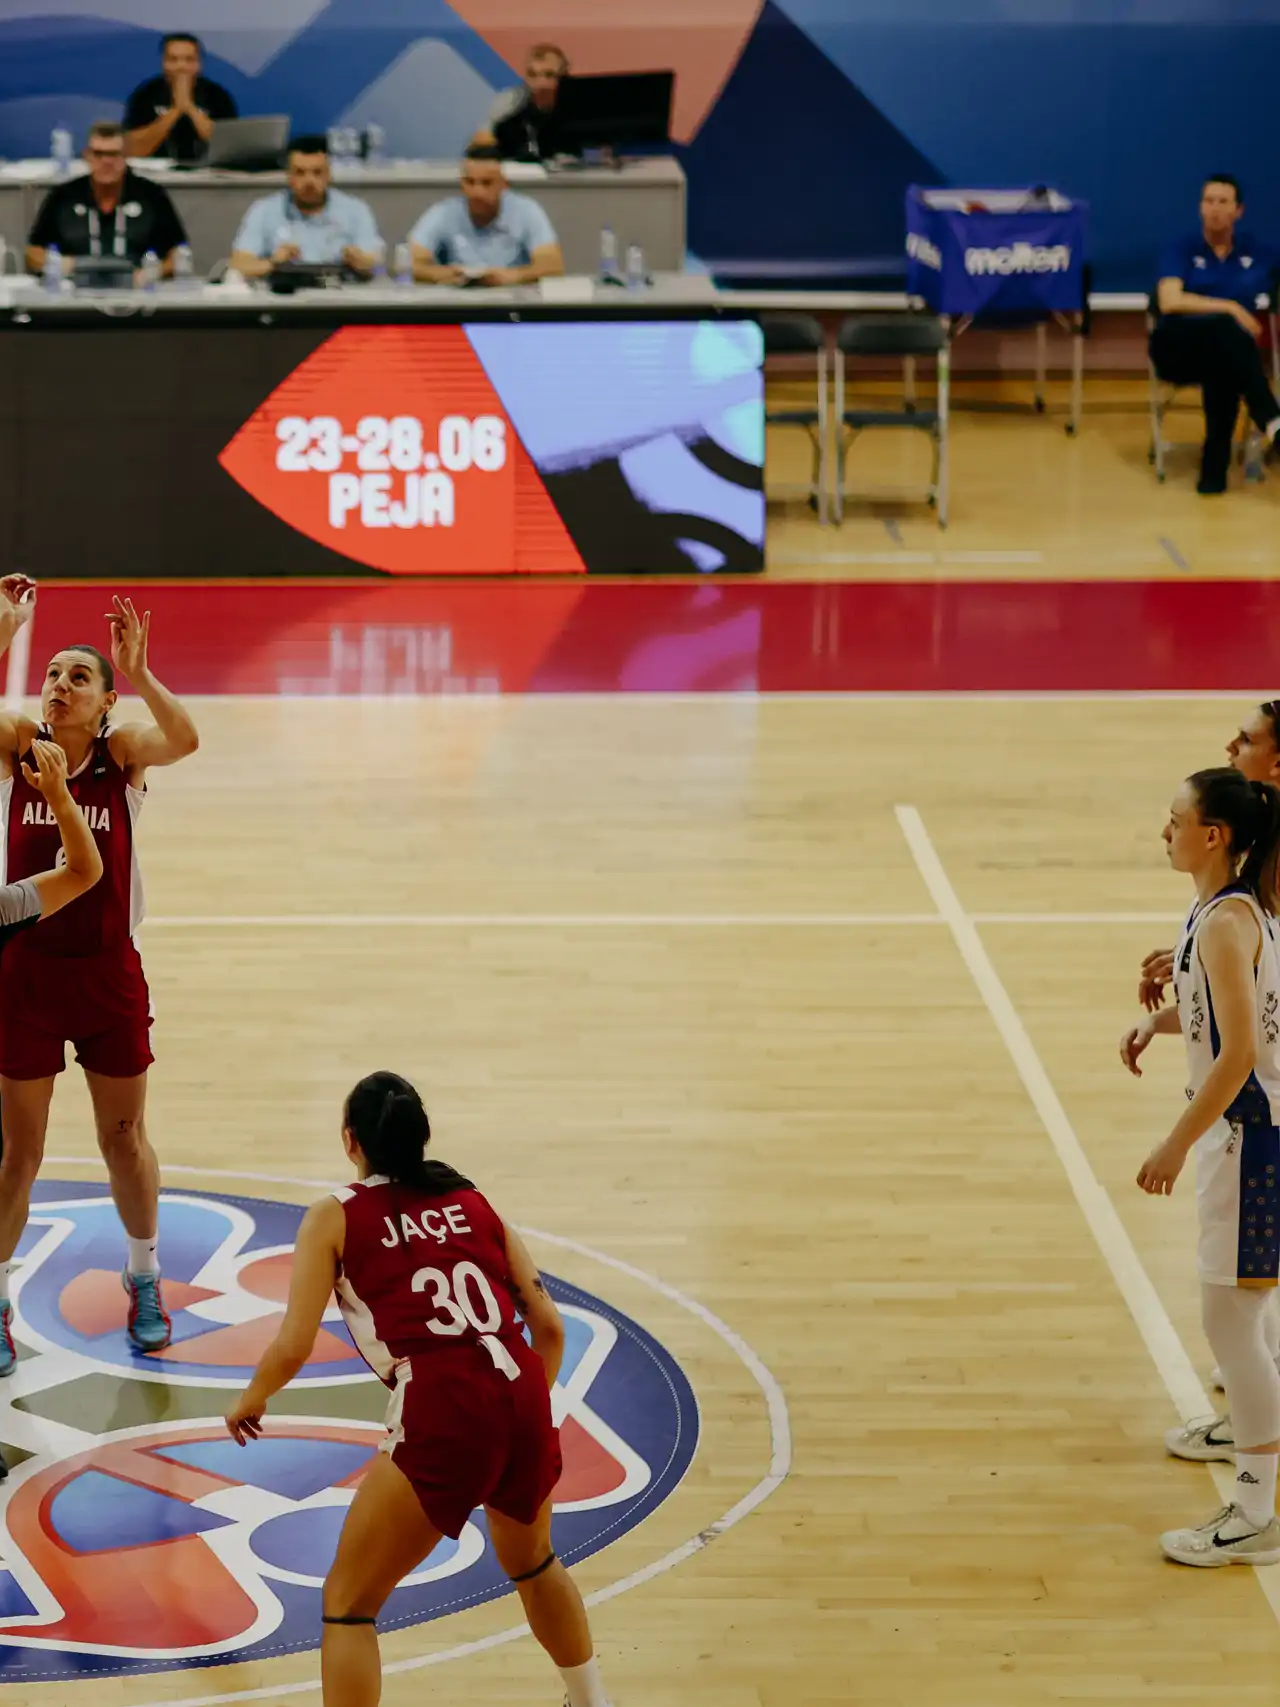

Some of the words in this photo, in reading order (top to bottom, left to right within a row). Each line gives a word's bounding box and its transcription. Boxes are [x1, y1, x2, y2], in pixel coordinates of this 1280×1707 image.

[965, 242, 1070, 276] molten
[275, 415, 506, 472] 23-28.06
[328, 472, 455, 529] PEJA
[21, 801, 111, 832] ALBNIA
[380, 1204, 472, 1249] JAÇE
[411, 1260, 502, 1337] 30
